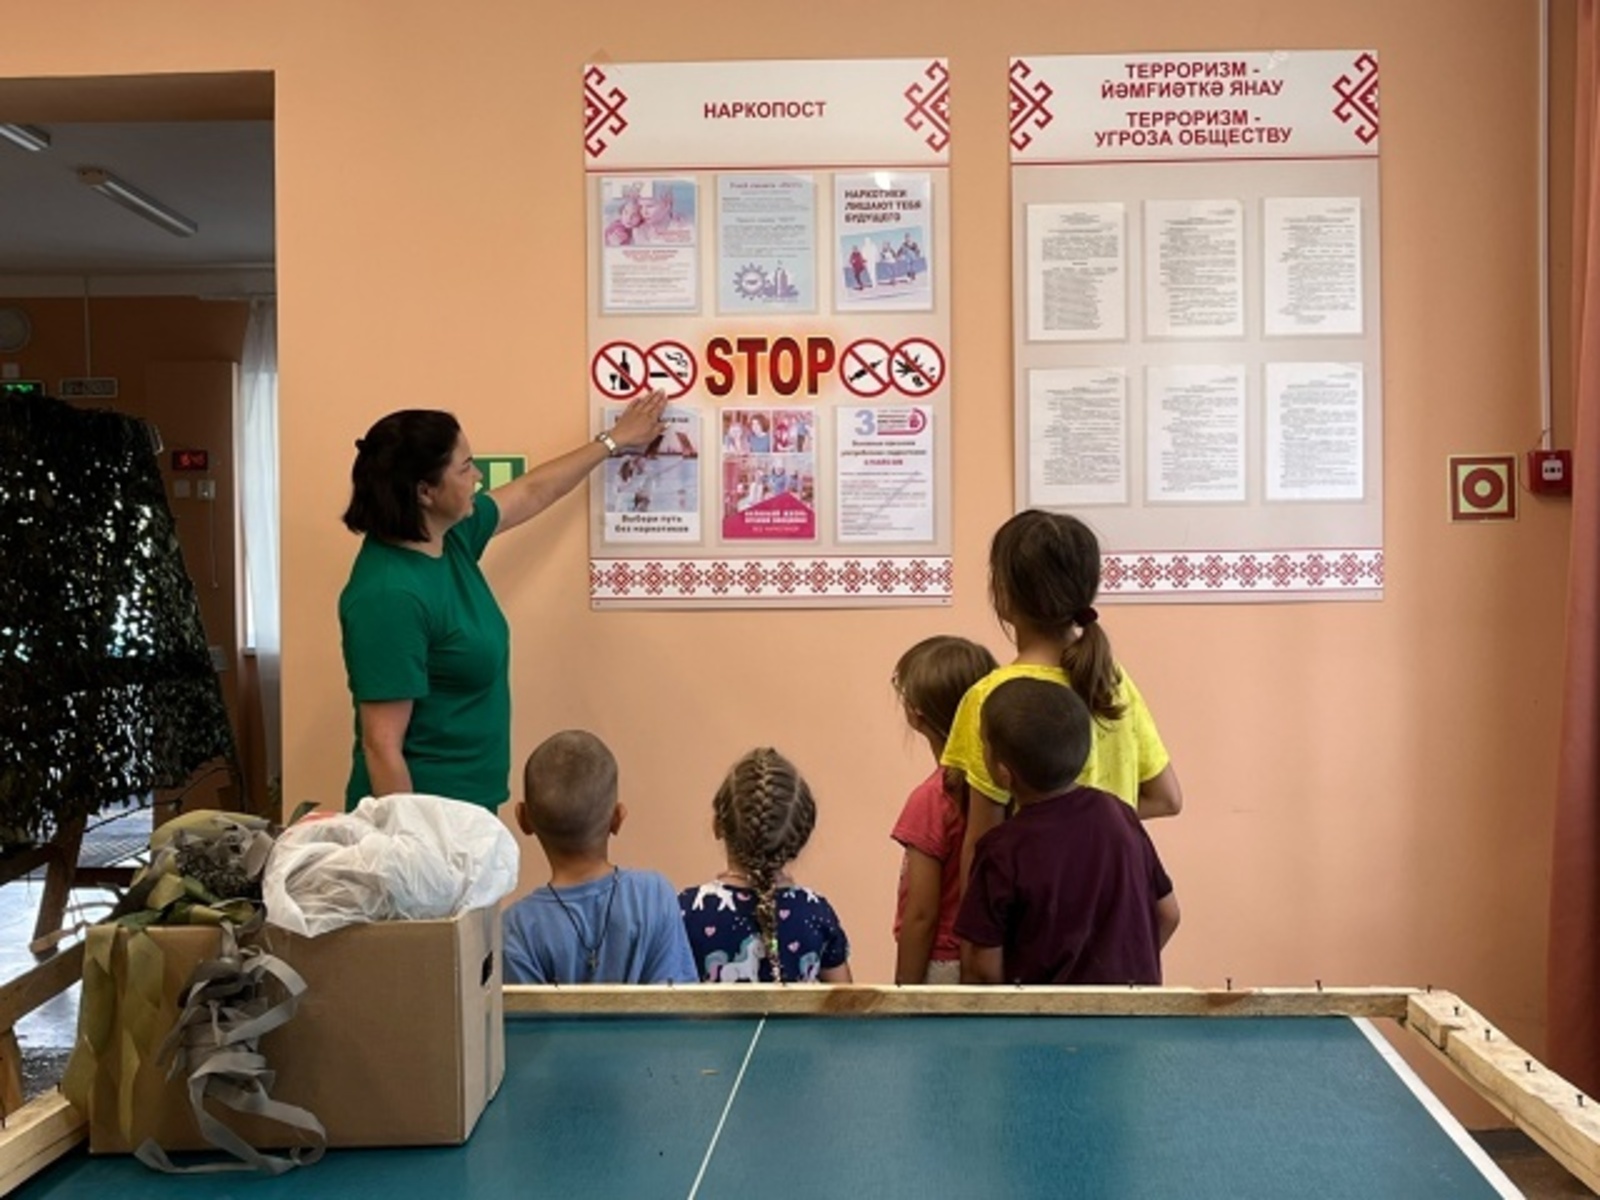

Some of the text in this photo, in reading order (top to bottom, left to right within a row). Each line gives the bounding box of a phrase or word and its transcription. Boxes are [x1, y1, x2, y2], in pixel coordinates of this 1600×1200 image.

[1125, 62, 1246, 79] ТЕРРОРИЗМ
[1229, 80, 1283, 96] ЯНАУ
[703, 101, 827, 119] НАРКОПОСТ
[1126, 110, 1248, 128] ТЕРРОРИЗМ
[1094, 127, 1292, 147] УГРОЗА ОБЩЕСТВУ
[844, 189, 907, 199] НАРКОТИКИ
[844, 200, 921, 211] ЛИШАЮТ ТЕБЯ
[704, 337, 836, 397] STOP
